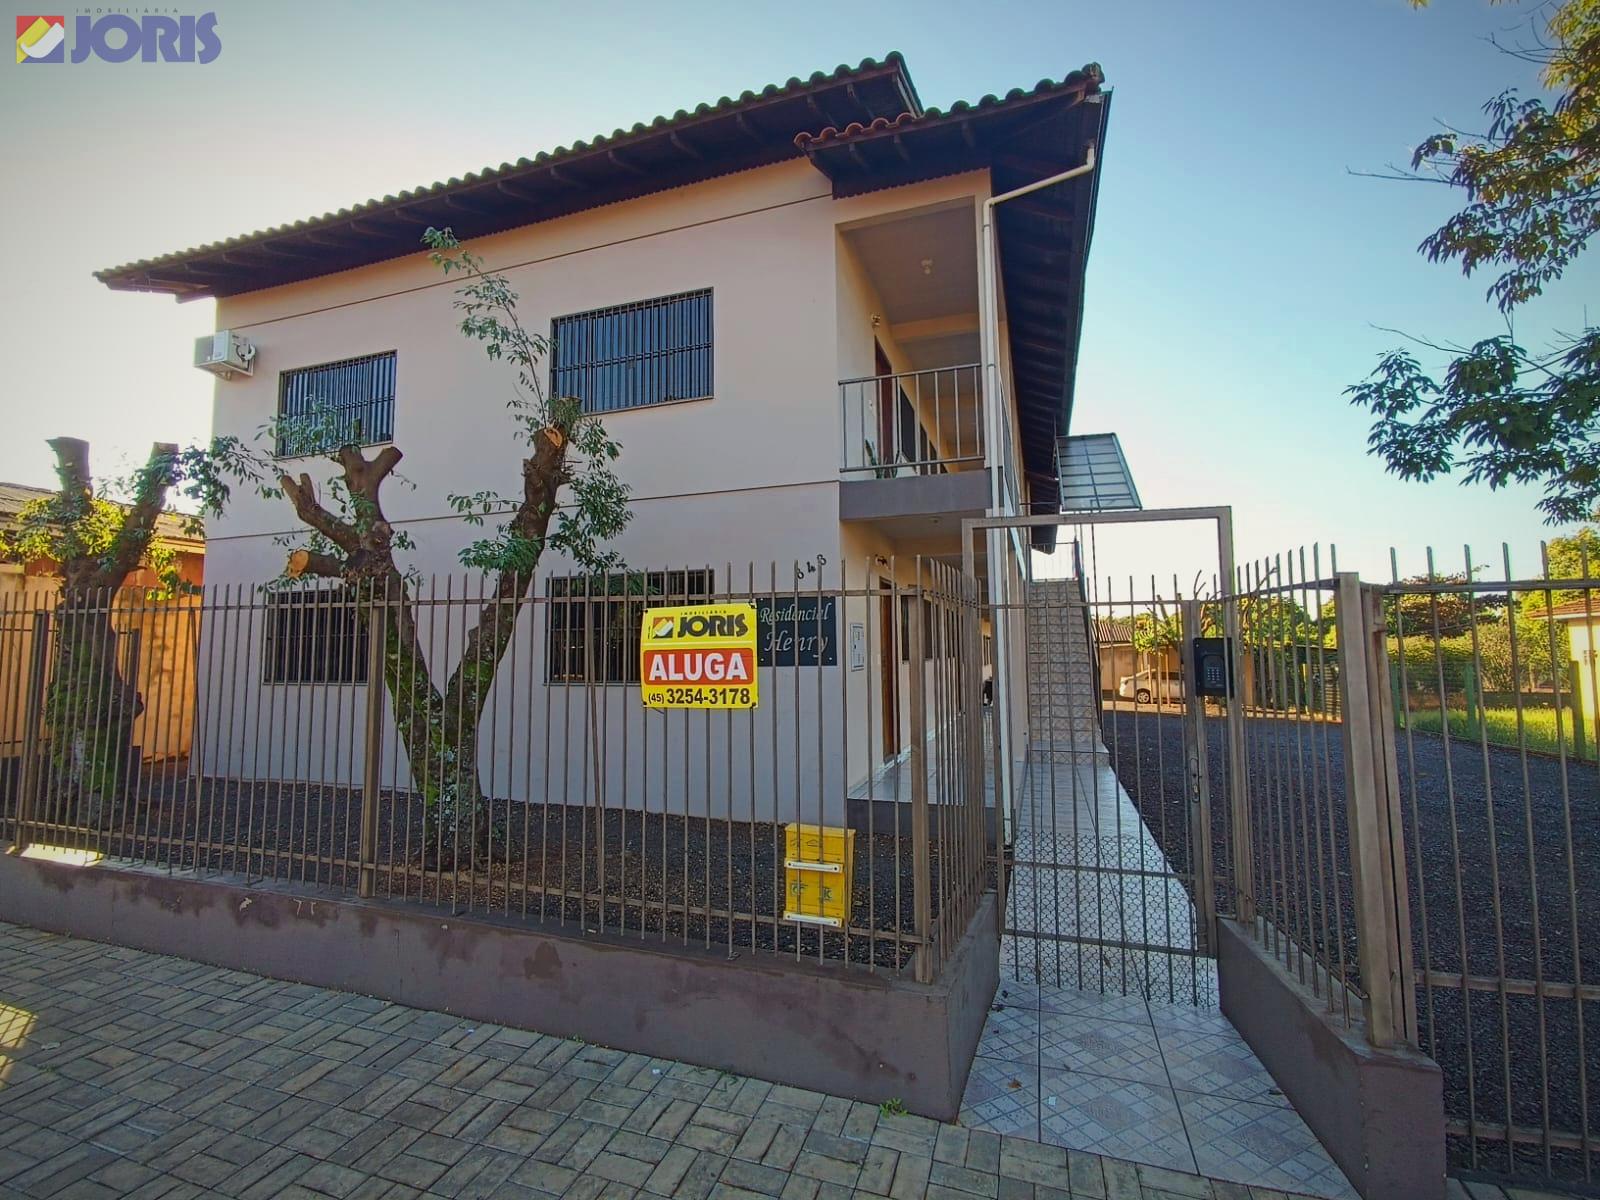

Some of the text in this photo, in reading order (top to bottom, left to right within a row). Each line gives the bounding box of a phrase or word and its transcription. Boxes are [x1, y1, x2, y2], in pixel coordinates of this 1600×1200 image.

[760, 602, 832, 625] Residencial
[677, 614, 748, 638] JORIS
[764, 630, 828, 657] Henry
[649, 653, 748, 681] ALUGA
[648, 688, 750, 705] (45) 3254-3178
